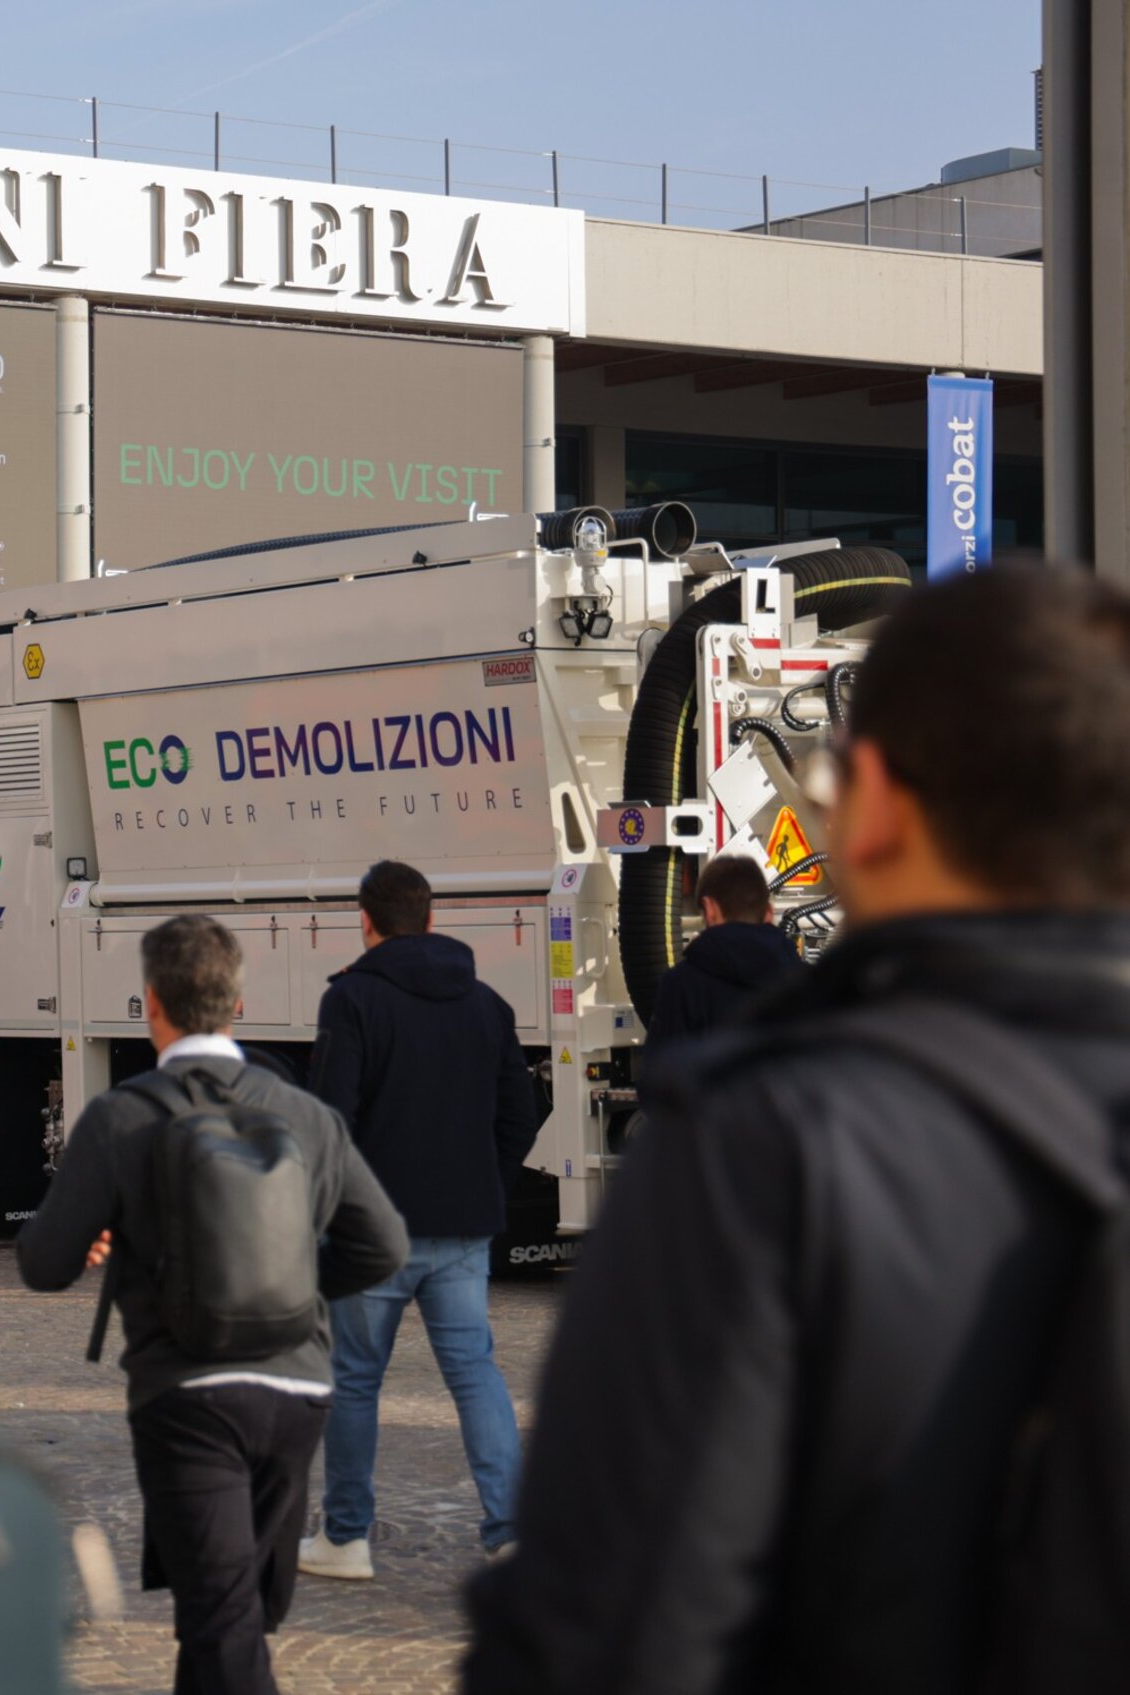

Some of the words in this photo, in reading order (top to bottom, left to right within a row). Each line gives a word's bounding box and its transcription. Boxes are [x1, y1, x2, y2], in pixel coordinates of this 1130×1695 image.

[141, 181, 516, 312] FIERA
[120, 443, 256, 491] ENJOY
[267, 453, 376, 499] YOUR
[387, 462, 503, 506] VISIT
[946, 416, 976, 531] cobat
[486, 661, 531, 677] HARDOX
[103, 734, 193, 790] ECO
[215, 706, 516, 782] DEMOLIZIONI
[114, 804, 257, 832] RECOVER
[287, 798, 347, 821] THE
[380, 788, 523, 817] FUTURE
